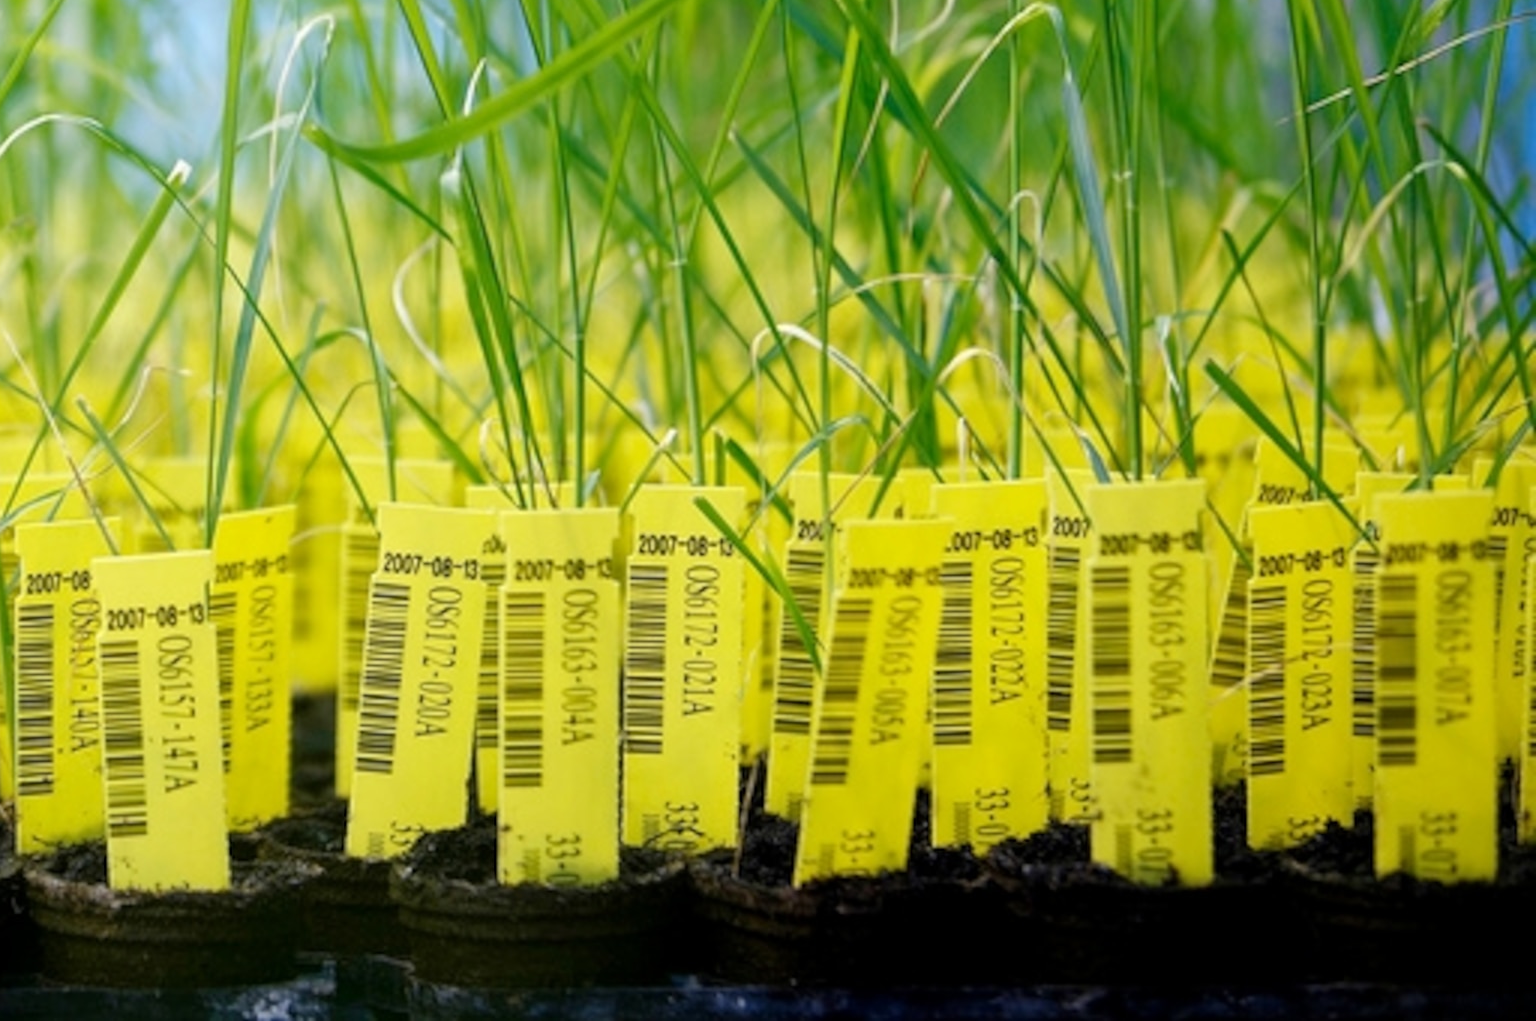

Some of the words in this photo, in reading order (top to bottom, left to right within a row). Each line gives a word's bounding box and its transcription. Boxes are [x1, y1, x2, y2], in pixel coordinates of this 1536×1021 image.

[384, 552, 479, 580] 2007-08-13
[514, 557, 611, 580] 2007-08-13
[945, 528, 1038, 553] 007-08-13
[1259, 547, 1345, 577] 2007-08-13
[107, 603, 205, 631] 2007-08-13
[414, 586, 463, 738] OS6172-020A
[560, 589, 599, 746] OS6163-004A
[682, 564, 721, 717] OS6172-021A
[989, 556, 1026, 706] OS6172-022A
[1301, 579, 1333, 731] OS6172-023A
[157, 634, 199, 794] OS6157-147A
